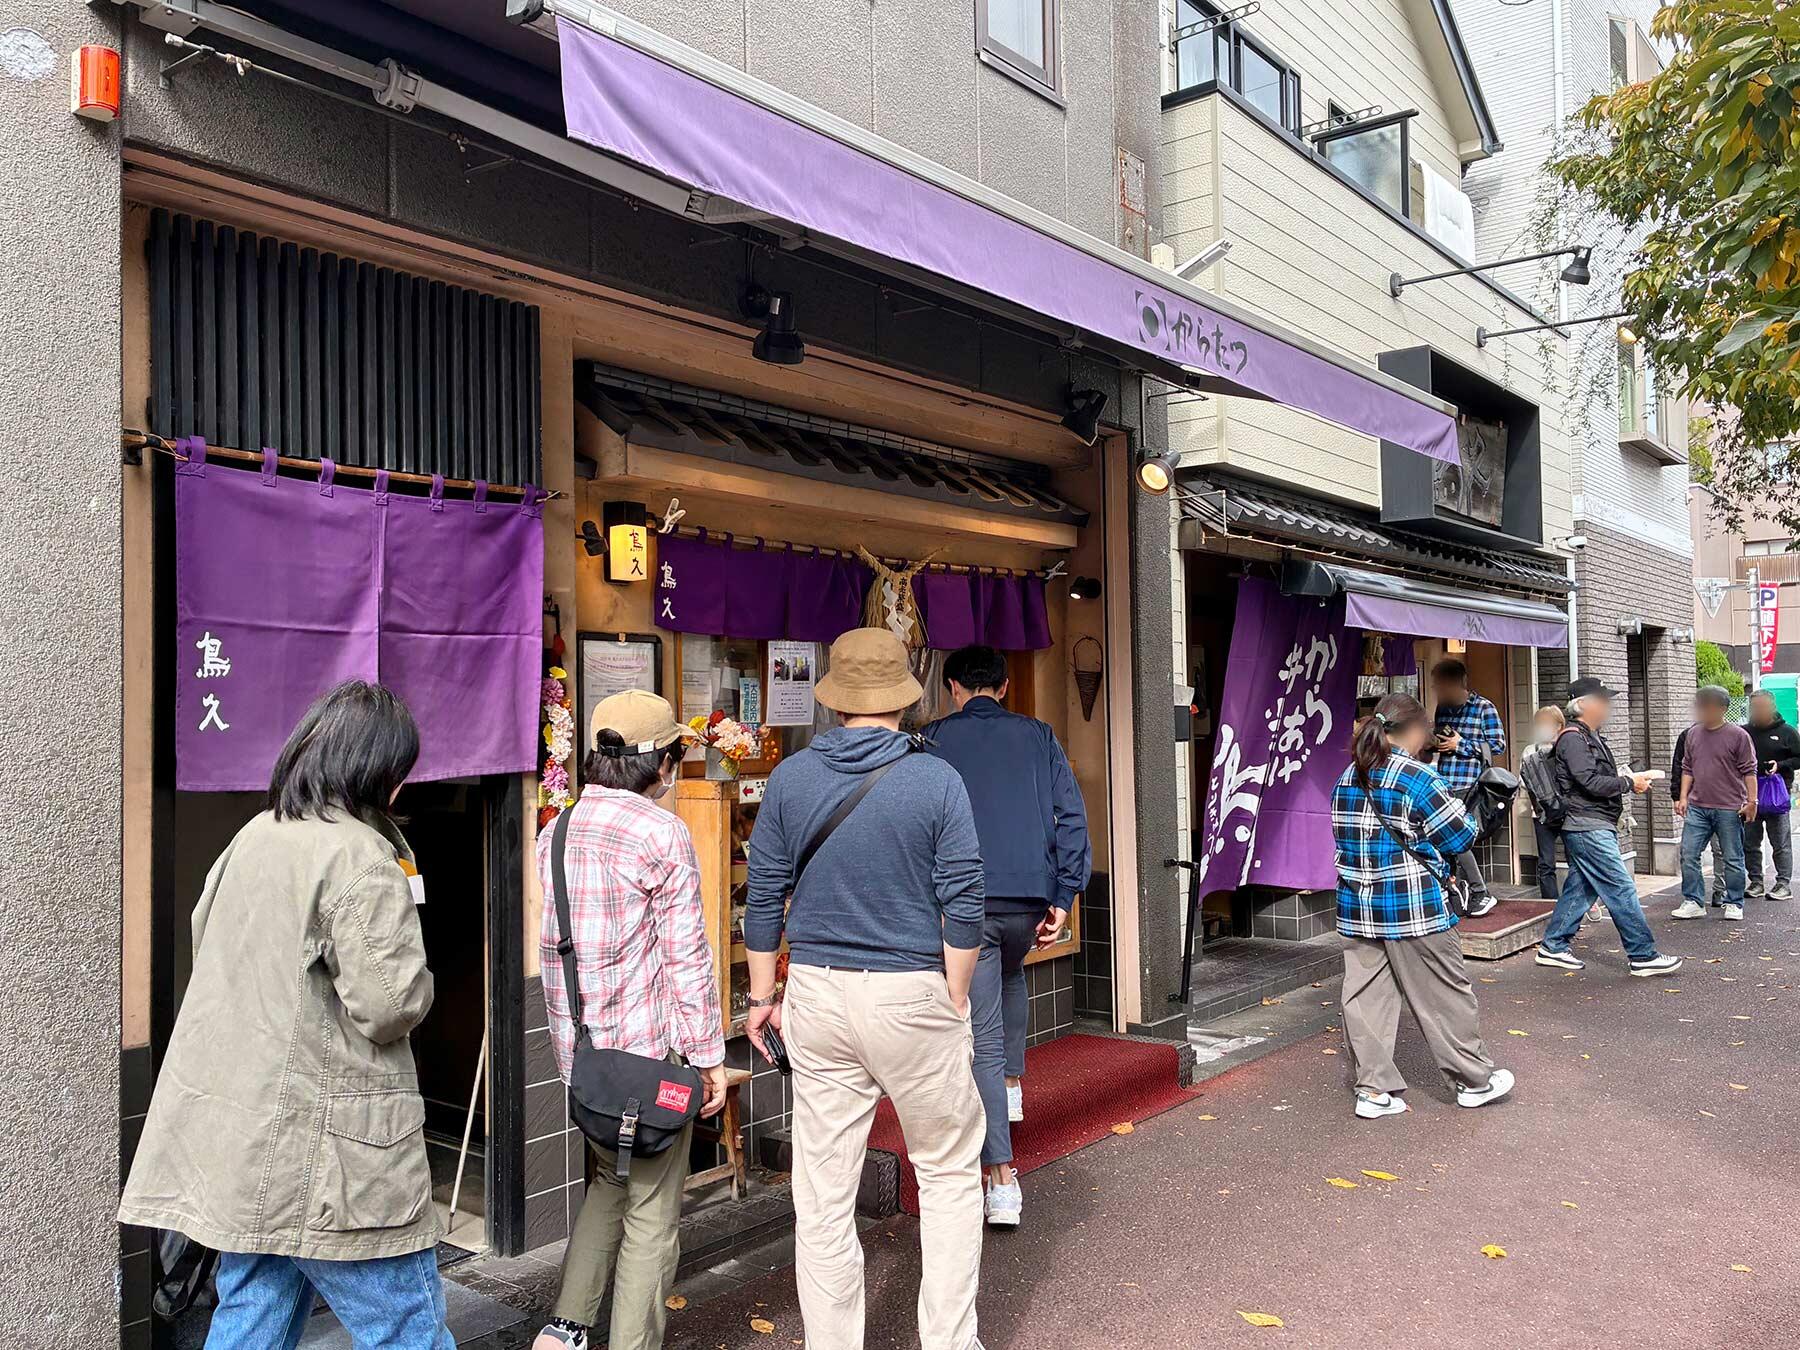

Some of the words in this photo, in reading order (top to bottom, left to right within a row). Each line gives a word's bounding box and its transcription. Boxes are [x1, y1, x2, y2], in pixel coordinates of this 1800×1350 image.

[629, 529, 643, 575] 鳥久
[661, 560, 677, 620] 鳥久
[1760, 589, 1776, 607] P
[195, 630, 231, 732] 鳥久
